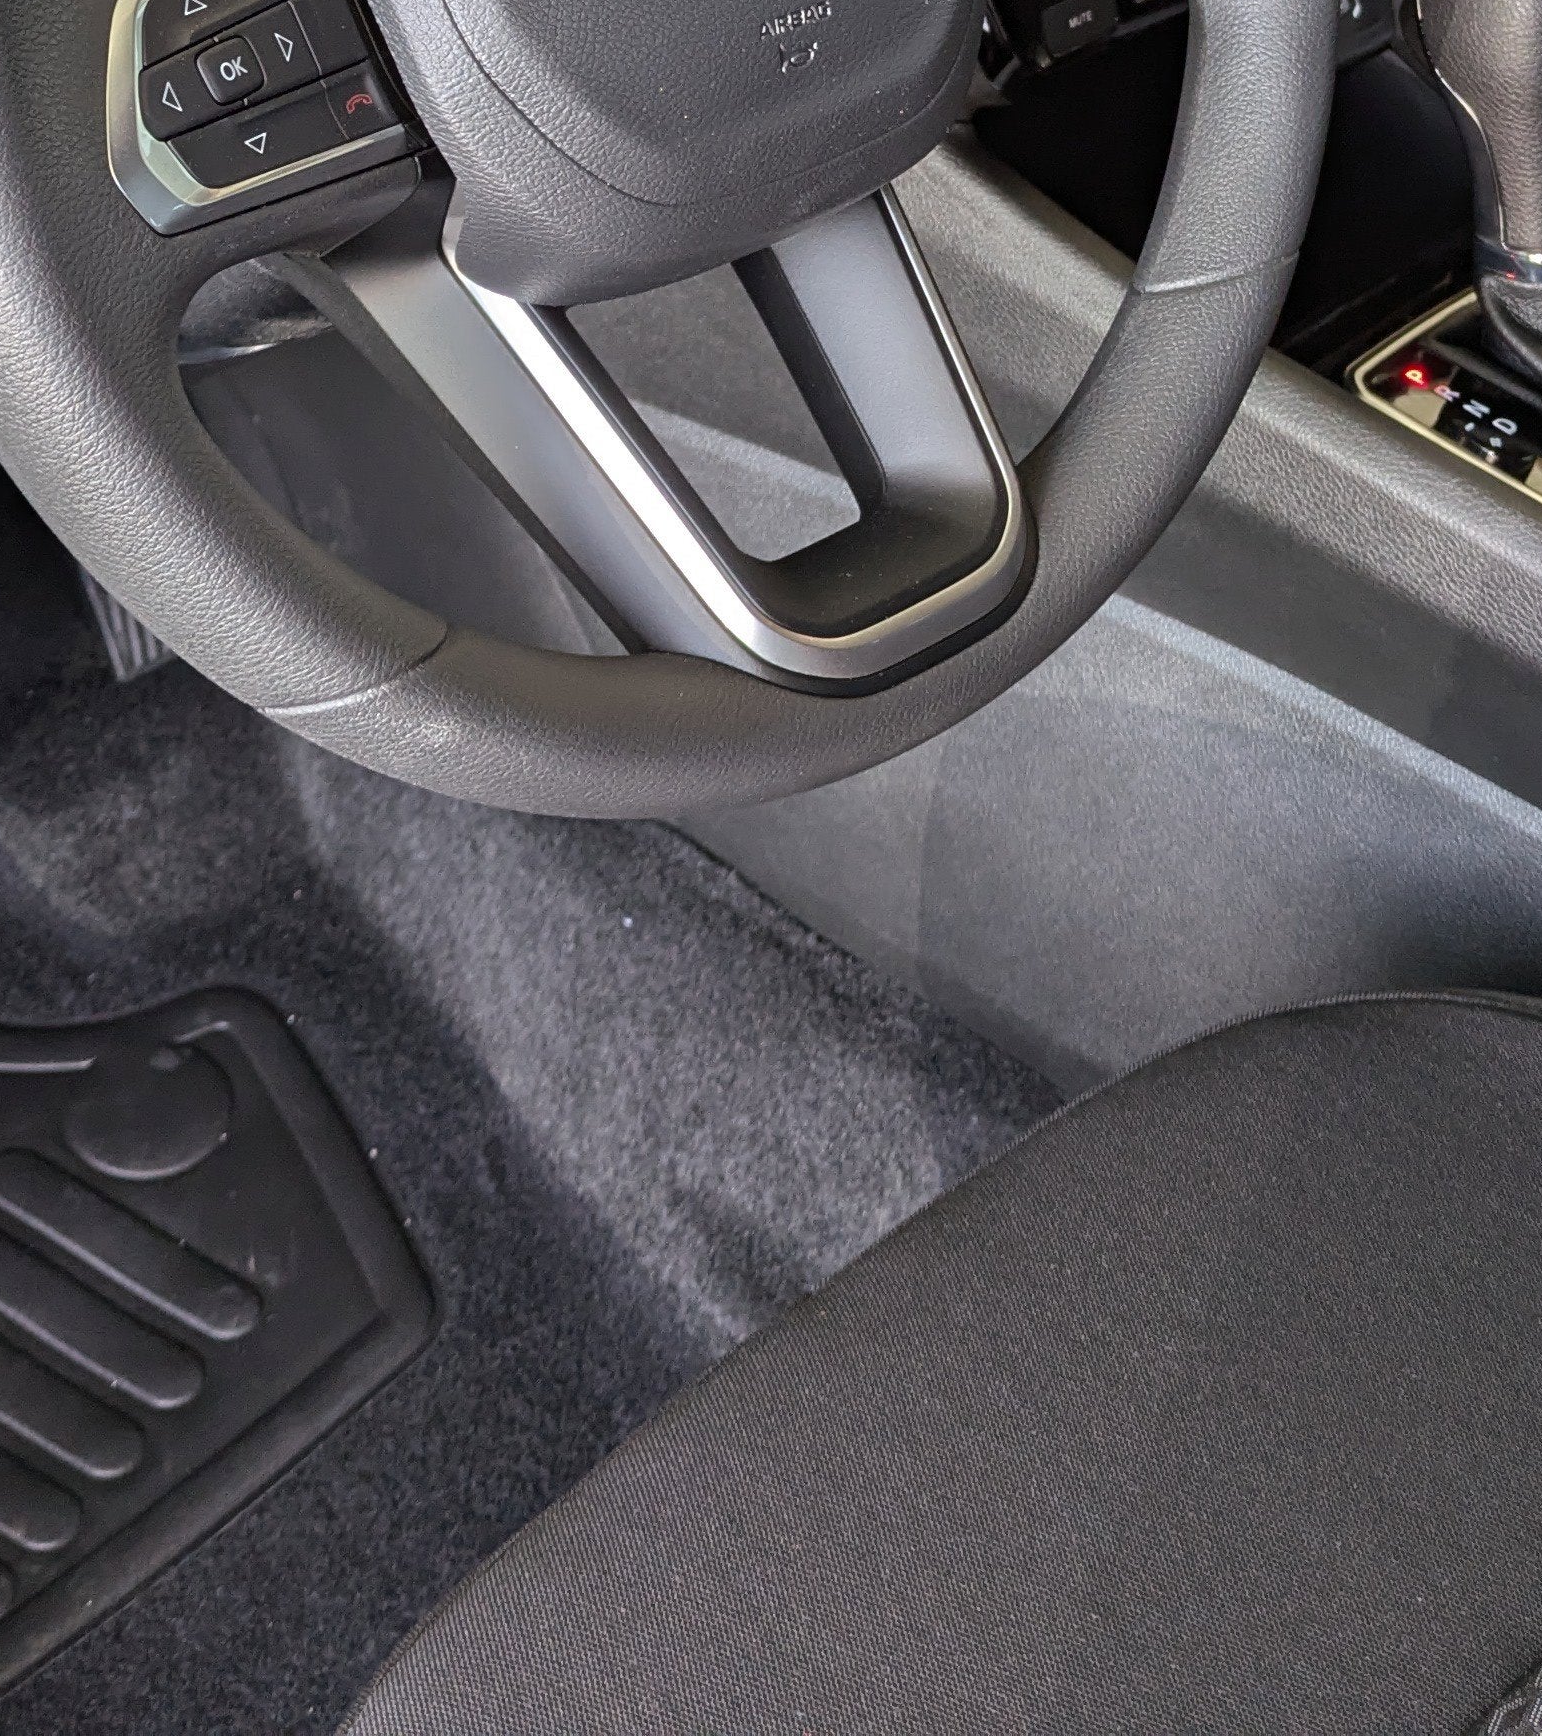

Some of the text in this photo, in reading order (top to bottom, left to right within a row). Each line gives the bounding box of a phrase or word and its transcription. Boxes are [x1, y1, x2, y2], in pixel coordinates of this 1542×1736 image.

[760, 0, 832, 40] AIRBAG
[219, 55, 249, 82] OK
[1404, 369, 1425, 386] P
[1433, 384, 1461, 403] R
[1491, 417, 1519, 436] D
